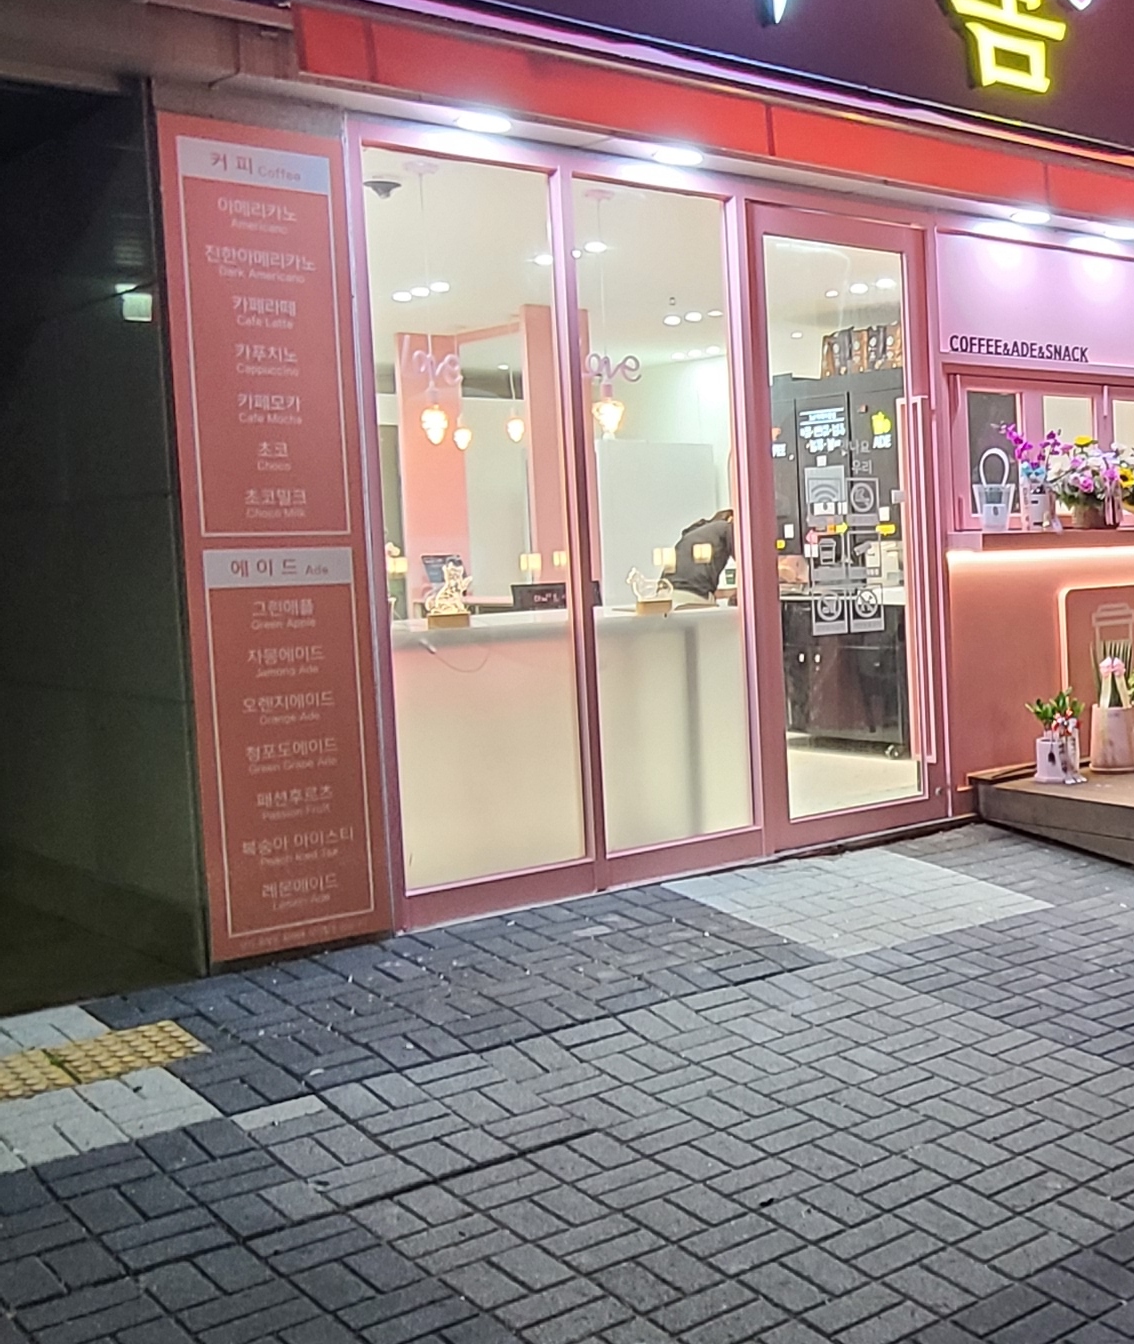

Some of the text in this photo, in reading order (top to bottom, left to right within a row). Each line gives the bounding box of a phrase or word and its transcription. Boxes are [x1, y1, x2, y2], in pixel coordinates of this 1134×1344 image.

[258, 165, 302, 182] Coffee
[217, 196, 297, 222] 아메리카노
[230, 218, 289, 235] Americano
[205, 244, 317, 272] 진한아메리카노
[249, 269, 306, 284] Americano
[232, 295, 297, 317] 카페라떼
[265, 317, 294, 330] Latte
[235, 343, 298, 363] 카푸치노
[949, 335, 1089, 363] COFFEE&ADE&SNACK
[238, 393, 300, 412] 카페모카
[258, 441, 289, 457] 초코
[257, 459, 292, 472] Choco
[852, 459, 872, 475] 우리
[245, 488, 307, 506] 초코밀크
[305, 564, 329, 575] Ade
[248, 645, 325, 665] 자몽에이드
[242, 691, 335, 713] 오렌지에이드
[246, 737, 338, 762] 청포도에이드
[294, 826, 354, 848] 아이스티
[261, 873, 338, 899] 레몬에이드
